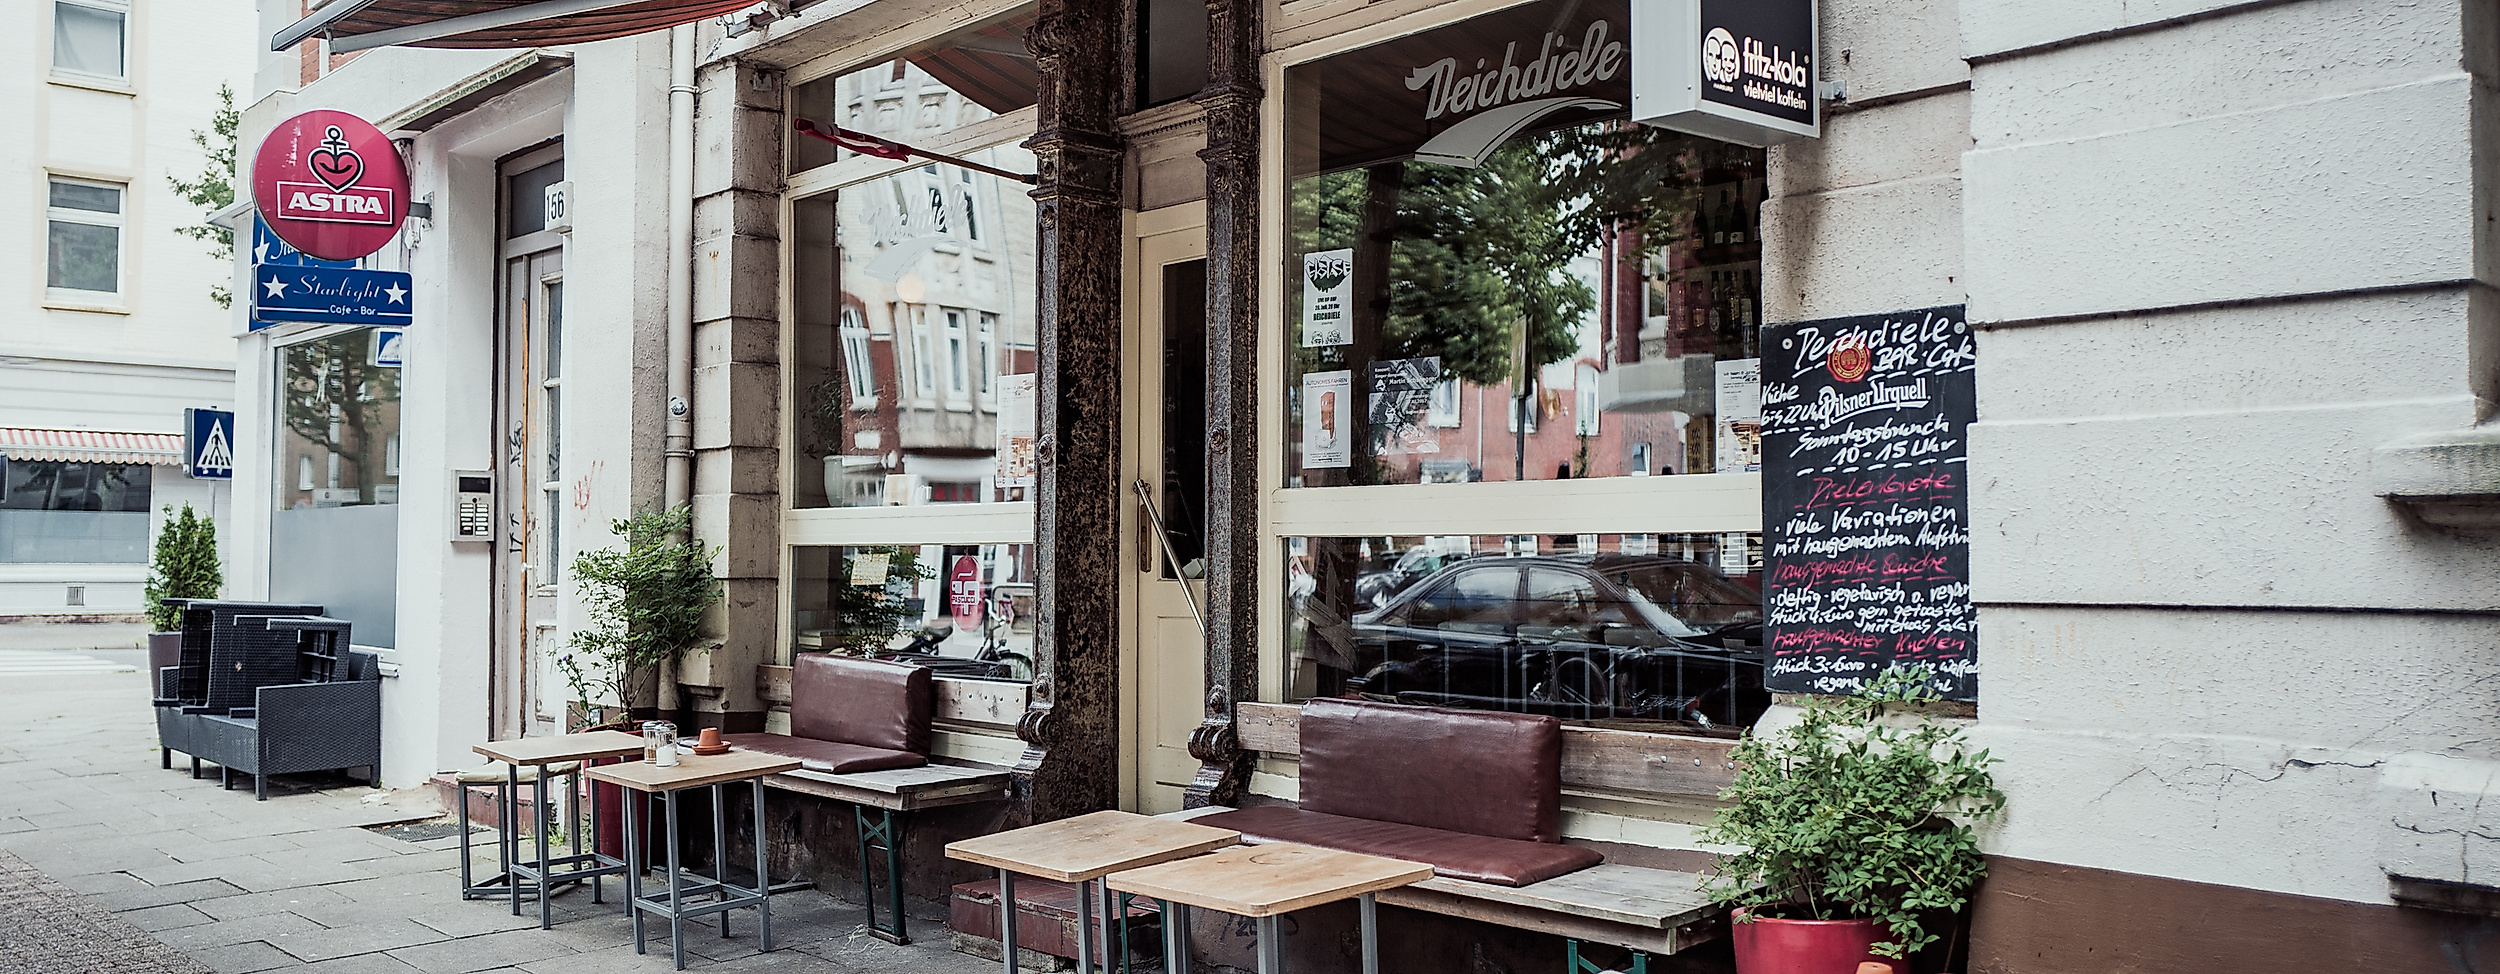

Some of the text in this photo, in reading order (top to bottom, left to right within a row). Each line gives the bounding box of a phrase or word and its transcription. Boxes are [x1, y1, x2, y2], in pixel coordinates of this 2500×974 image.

[1404, 20, 1623, 120] Deichdiele
[1743, 37, 1806, 88] fritz-kola
[1743, 80, 1807, 110] vielviel koffein
[288, 191, 384, 215] ASTRA
[546, 190, 565, 223] 156
[293, 274, 380, 303] Starlight
[330, 304, 351, 316] Cafe
[360, 305, 376, 316] Bar
[1795, 312, 1951, 370] Deichdiele
[1818, 385, 1874, 431] Pilsner
[1790, 413, 1950, 459] Sonntagsbrunch
[1910, 437, 1958, 457] Uhr
[1832, 503, 1957, 533] Variationen
[1772, 537, 1801, 557] mit
[1882, 551, 1947, 575] Quiche
[1895, 633, 1966, 653] Kuchen
